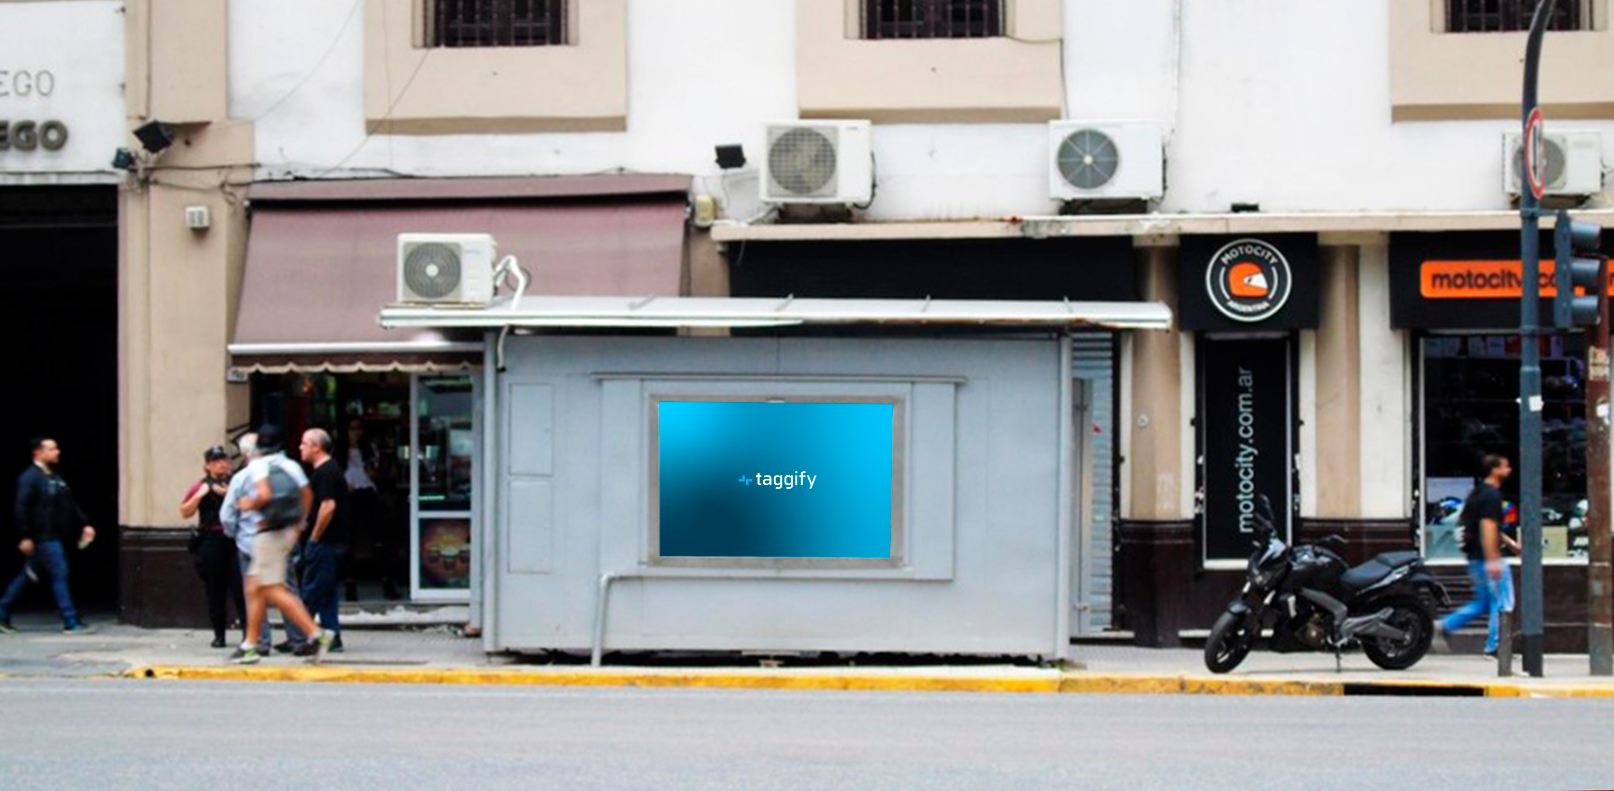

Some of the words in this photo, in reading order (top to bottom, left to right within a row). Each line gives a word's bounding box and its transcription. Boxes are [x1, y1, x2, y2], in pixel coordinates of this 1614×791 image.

[1220, 244, 1278, 265] MOTOCITY
[1234, 366, 1259, 533] motocity.com.ar
[755, 470, 817, 490] taggify
